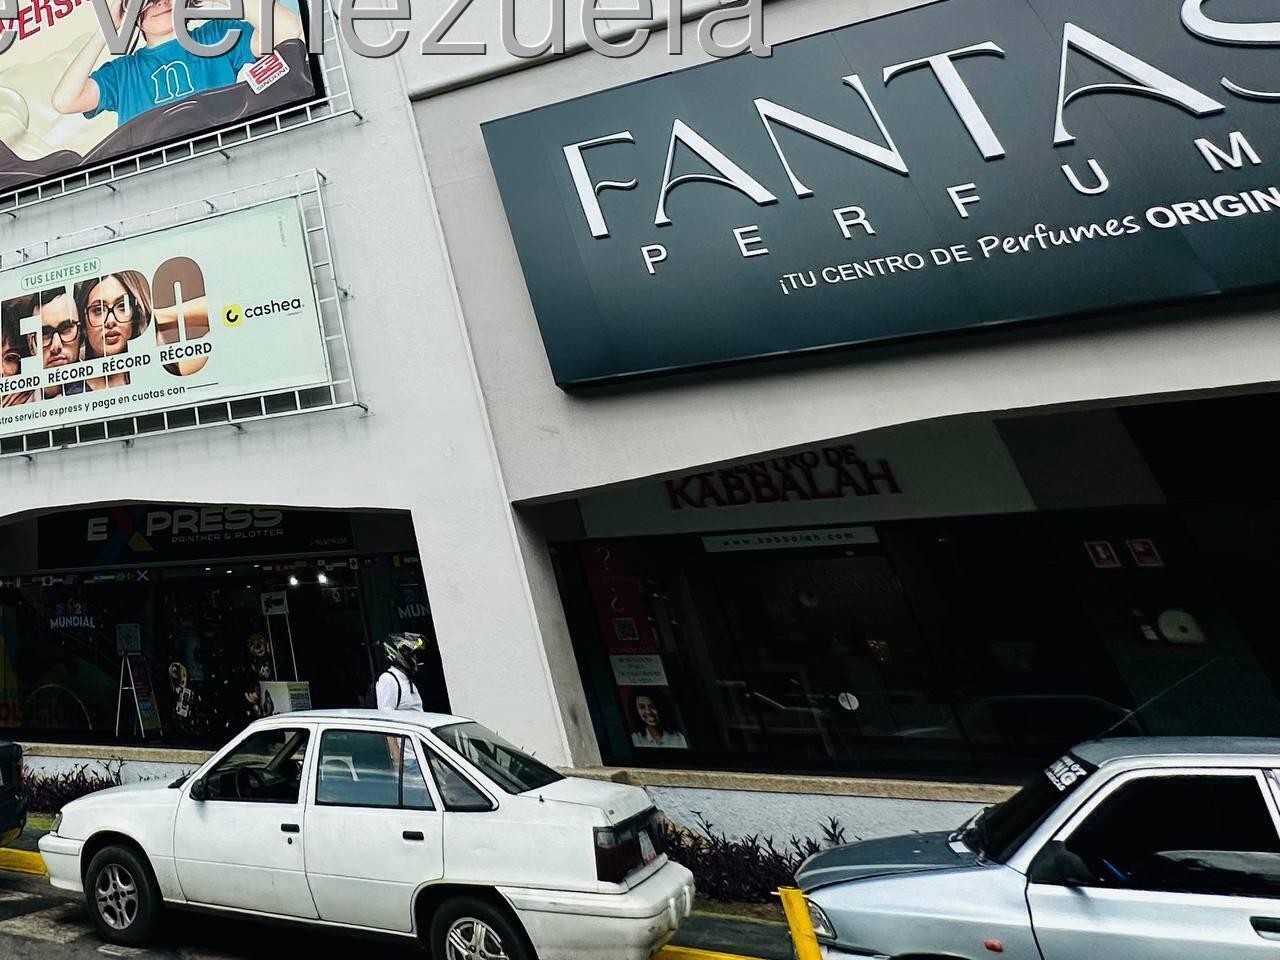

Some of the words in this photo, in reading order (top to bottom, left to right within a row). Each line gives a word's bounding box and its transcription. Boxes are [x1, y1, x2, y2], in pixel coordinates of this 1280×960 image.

[779, 271, 817, 295] ¡TU
[822, 251, 925, 285] CENTRO
[930, 244, 973, 266] DE
[977, 214, 1142, 259] Perfumes
[1145, 186, 1280, 230] ORIGIN
[24, 275, 44, 288] TUS
[45, 266, 81, 283] LENTES
[83, 260, 98, 275] EN
[244, 298, 301, 318] cashea
[48, 365, 94, 385] RÉCORD
[102, 353, 151, 373] RÉCORD
[160, 342, 213, 363] RÉCORD
[15, 408, 47, 422] servicio
[49, 403, 83, 418] express
[84, 402, 91, 413] y
[92, 397, 116, 412] paga
[118, 395, 130, 404] en
[132, 389, 165, 402] cuotas
[167, 385, 186, 396] con
[665, 460, 903, 510] KABBALAH
[235, 528, 284, 539] PLOTTER
[50, 615, 96, 630] MUNDIAL
